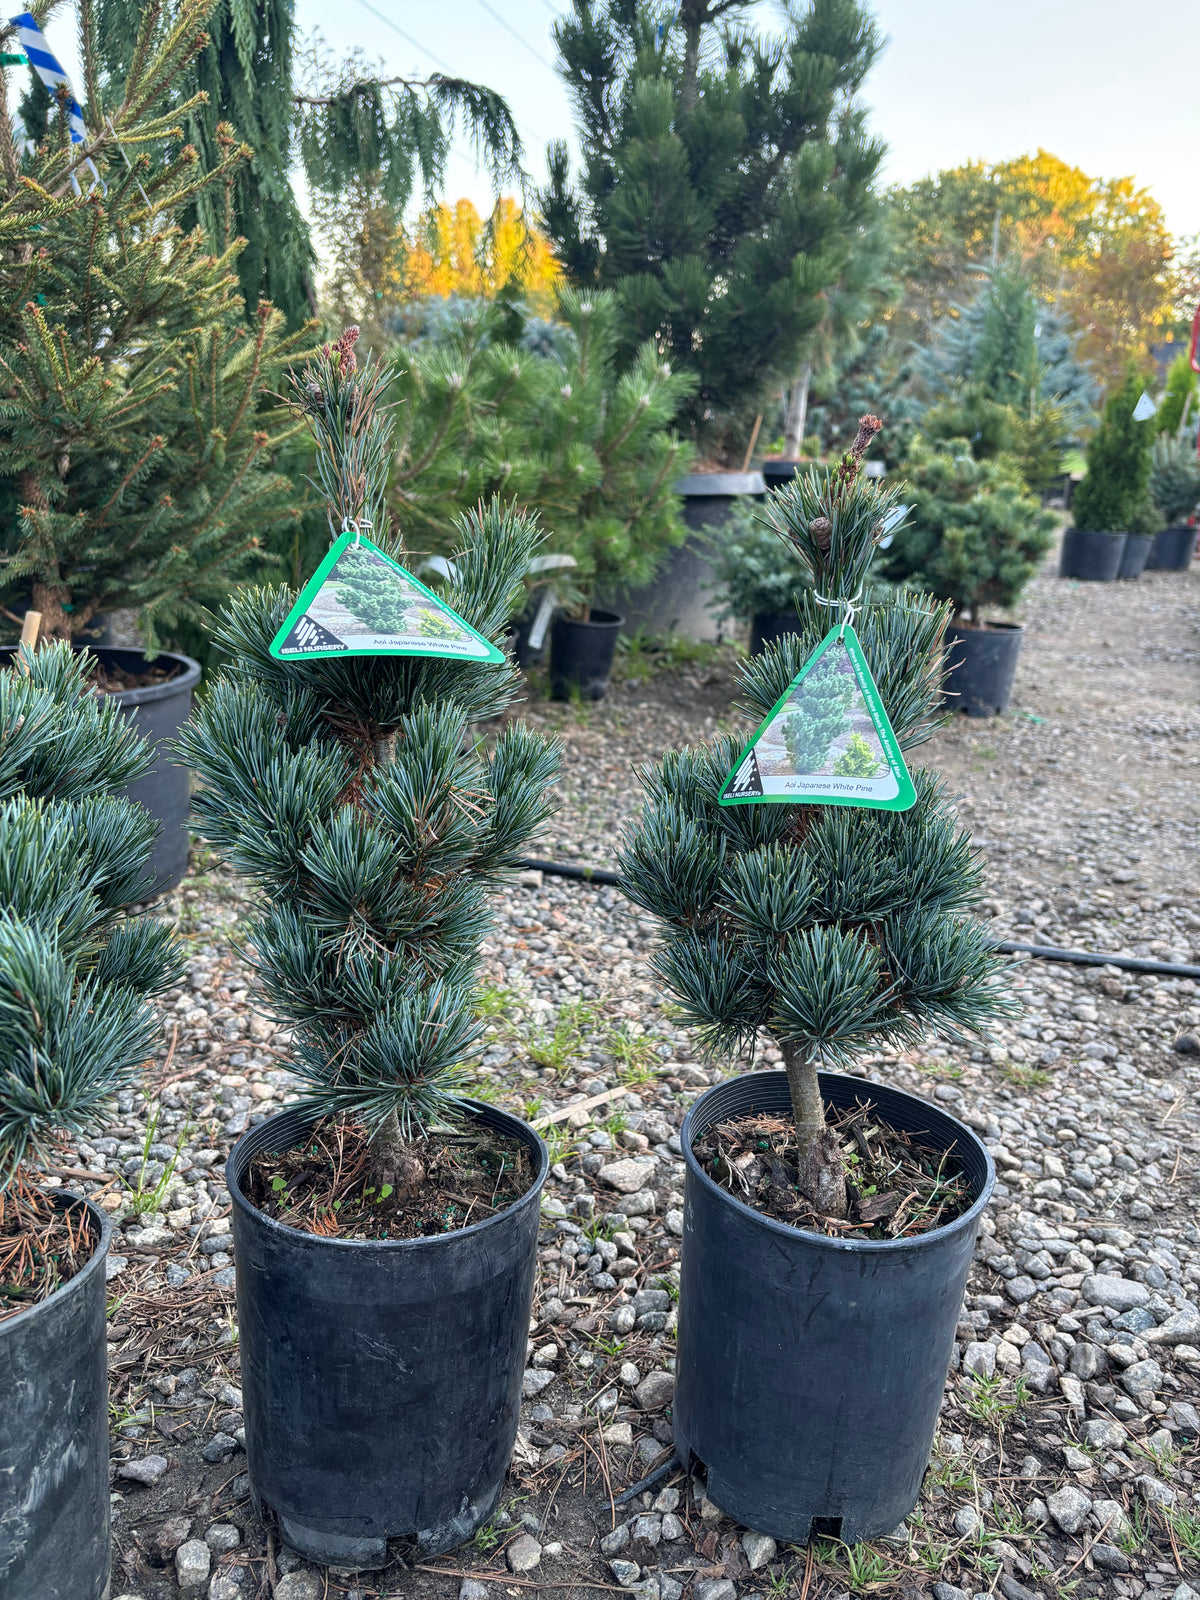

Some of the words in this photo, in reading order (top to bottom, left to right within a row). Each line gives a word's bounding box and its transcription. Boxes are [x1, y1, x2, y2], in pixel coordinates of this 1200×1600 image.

[281, 646, 303, 655] ISELI
[304, 644, 345, 653] NURSERY
[388, 639, 426, 647] Japanese
[427, 641, 450, 649] White
[450, 643, 468, 651] Pine
[784, 781, 797, 789] Aoi
[797, 781, 831, 790] Japanese
[832, 783, 854, 791] White
[855, 784, 873, 792] Pine
